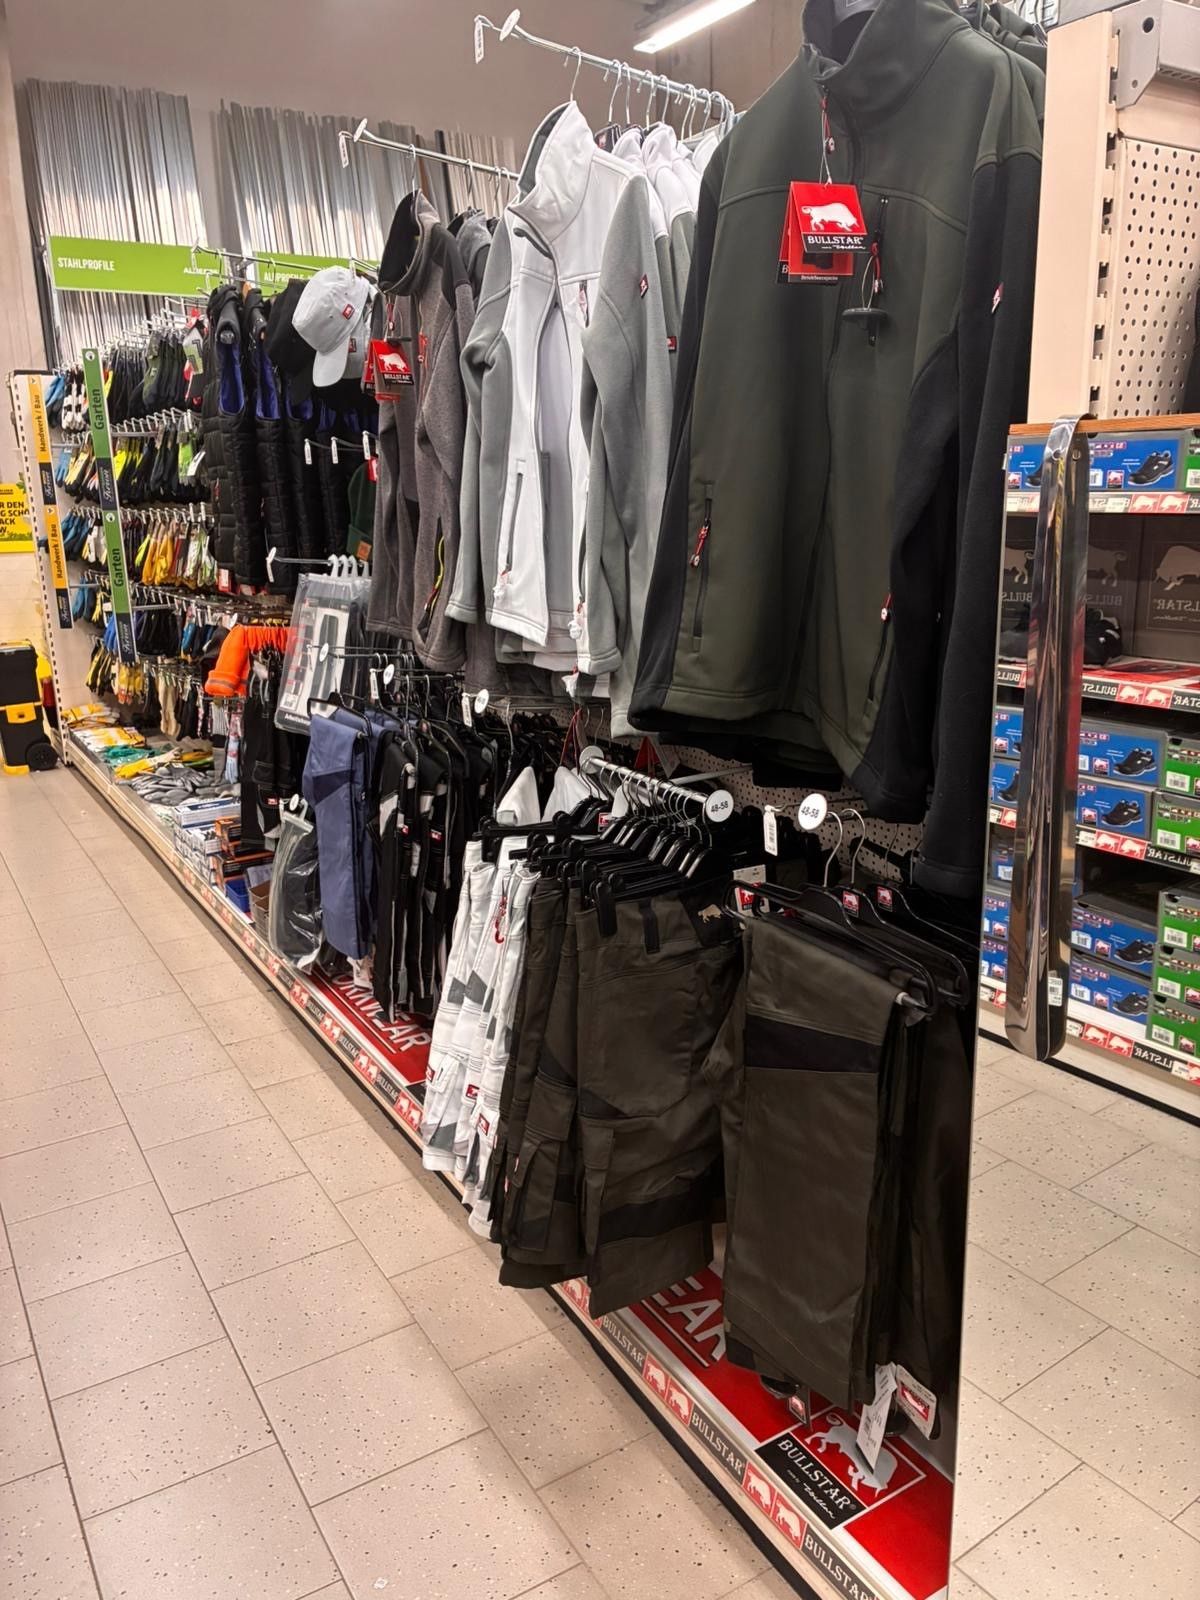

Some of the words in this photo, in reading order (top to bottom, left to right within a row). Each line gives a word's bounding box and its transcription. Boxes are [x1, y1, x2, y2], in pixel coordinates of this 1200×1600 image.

[807, 235, 863, 245] BULLSTAR
[57, 256, 115, 272] STAHLPROFILE
[34, 394, 42, 409] Bau
[91, 388, 105, 430] Garten
[34, 414, 47, 452] Handwerk
[7, 501, 25, 509] DEN
[50, 523, 59, 538] Bau
[52, 546, 64, 579] Handwerk
[111, 548, 124, 588] Garten
[710, 800, 729, 813] 48-58
[800, 806, 820, 818] 48-58
[602, 1315, 645, 1366] BULLSTAR
[691, 1412, 745, 1475] BULLSTAR
[777, 1438, 852, 1510] BULLSTAR
